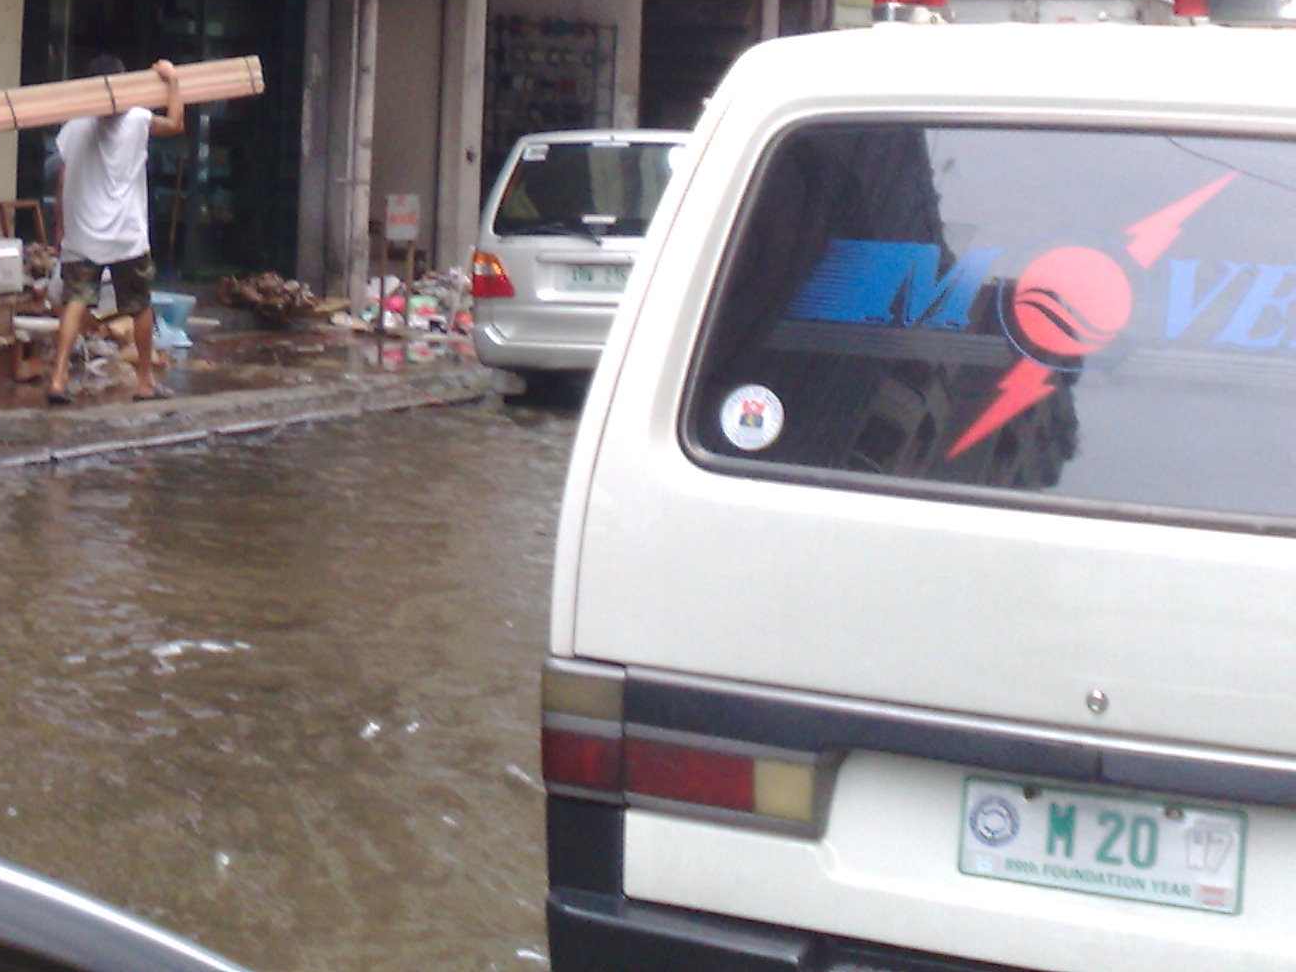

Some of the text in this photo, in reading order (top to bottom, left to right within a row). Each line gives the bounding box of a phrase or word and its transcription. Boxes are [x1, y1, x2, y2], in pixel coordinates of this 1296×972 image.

[1047, 802, 1160, 870] M 20
[1043, 863, 1146, 891] FOUNDATION
[1151, 879, 1192, 898] YEAR
